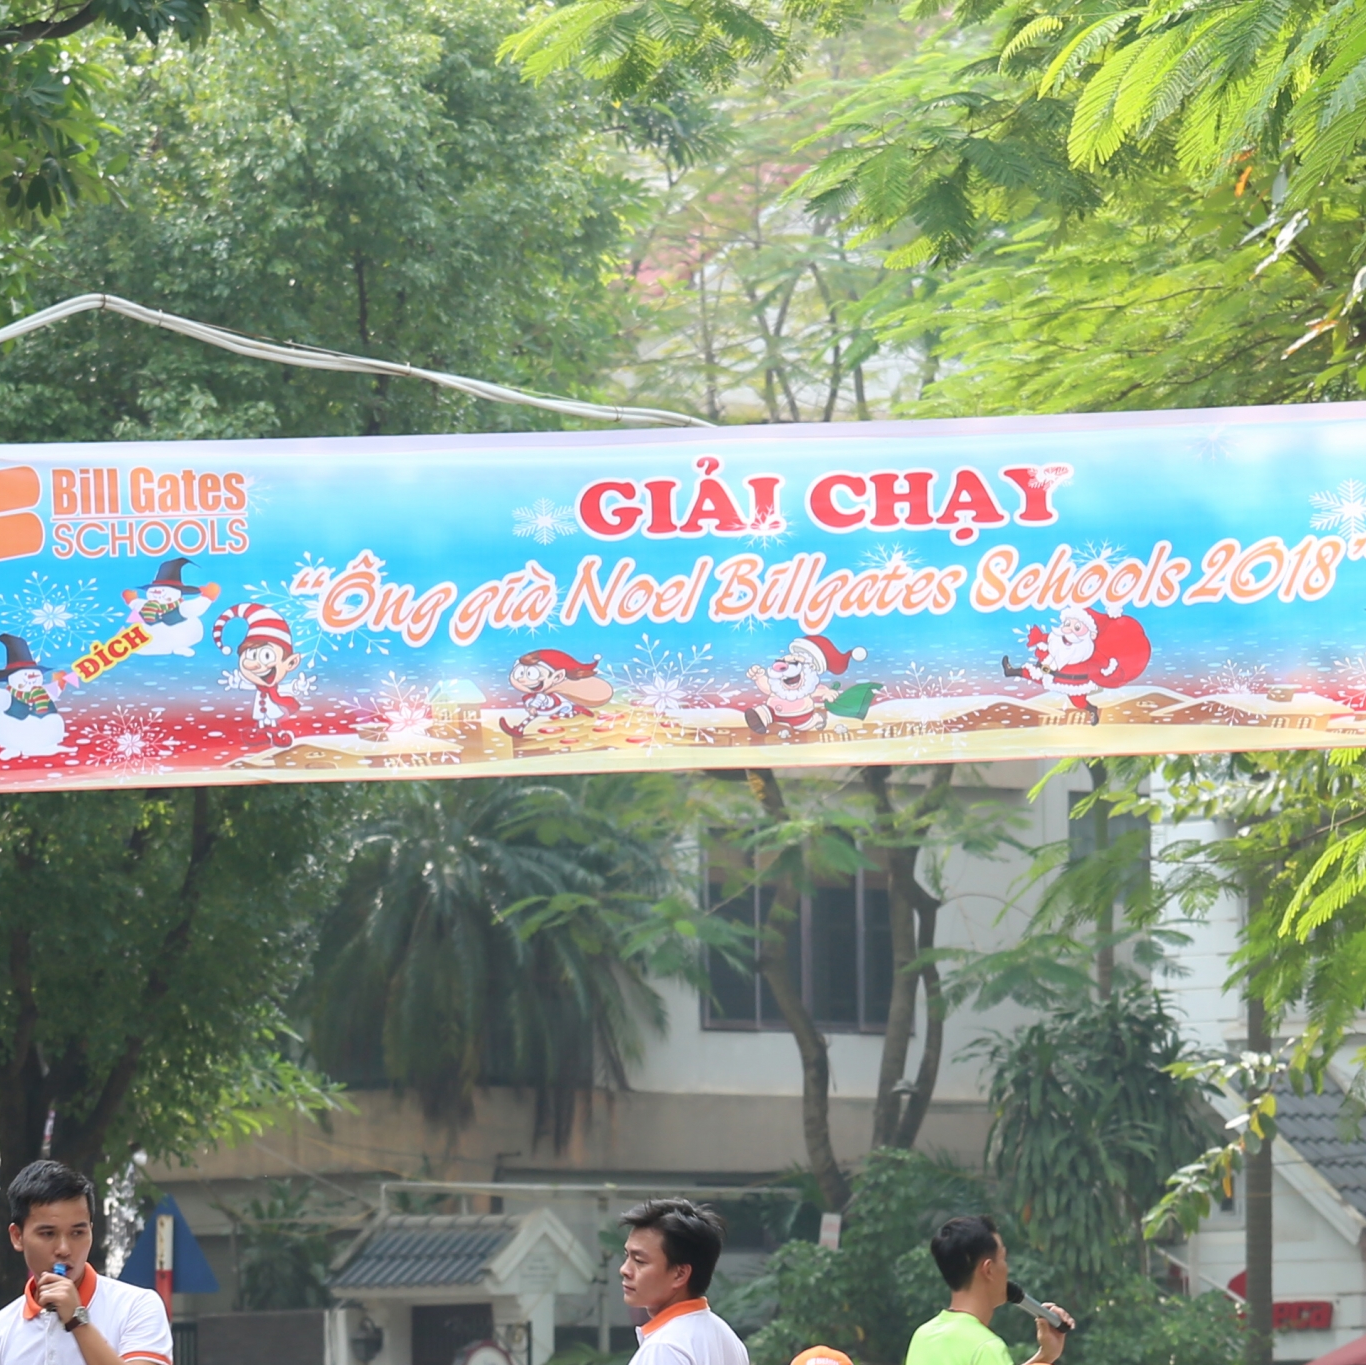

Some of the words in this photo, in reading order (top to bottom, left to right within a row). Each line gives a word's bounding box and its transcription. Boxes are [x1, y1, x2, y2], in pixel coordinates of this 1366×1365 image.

[52, 467, 120, 516] Bill
[129, 466, 247, 514] Gates
[579, 456, 783, 536] GIẢI
[809, 465, 1071, 541] CHẠY
[53, 518, 248, 557] SCHOOLS
[454, 563, 554, 641] già
[563, 557, 710, 622] Noel
[715, 555, 962, 632] Billgates
[976, 547, 1185, 609] Schools
[74, 625, 150, 681] ĐÍCH
